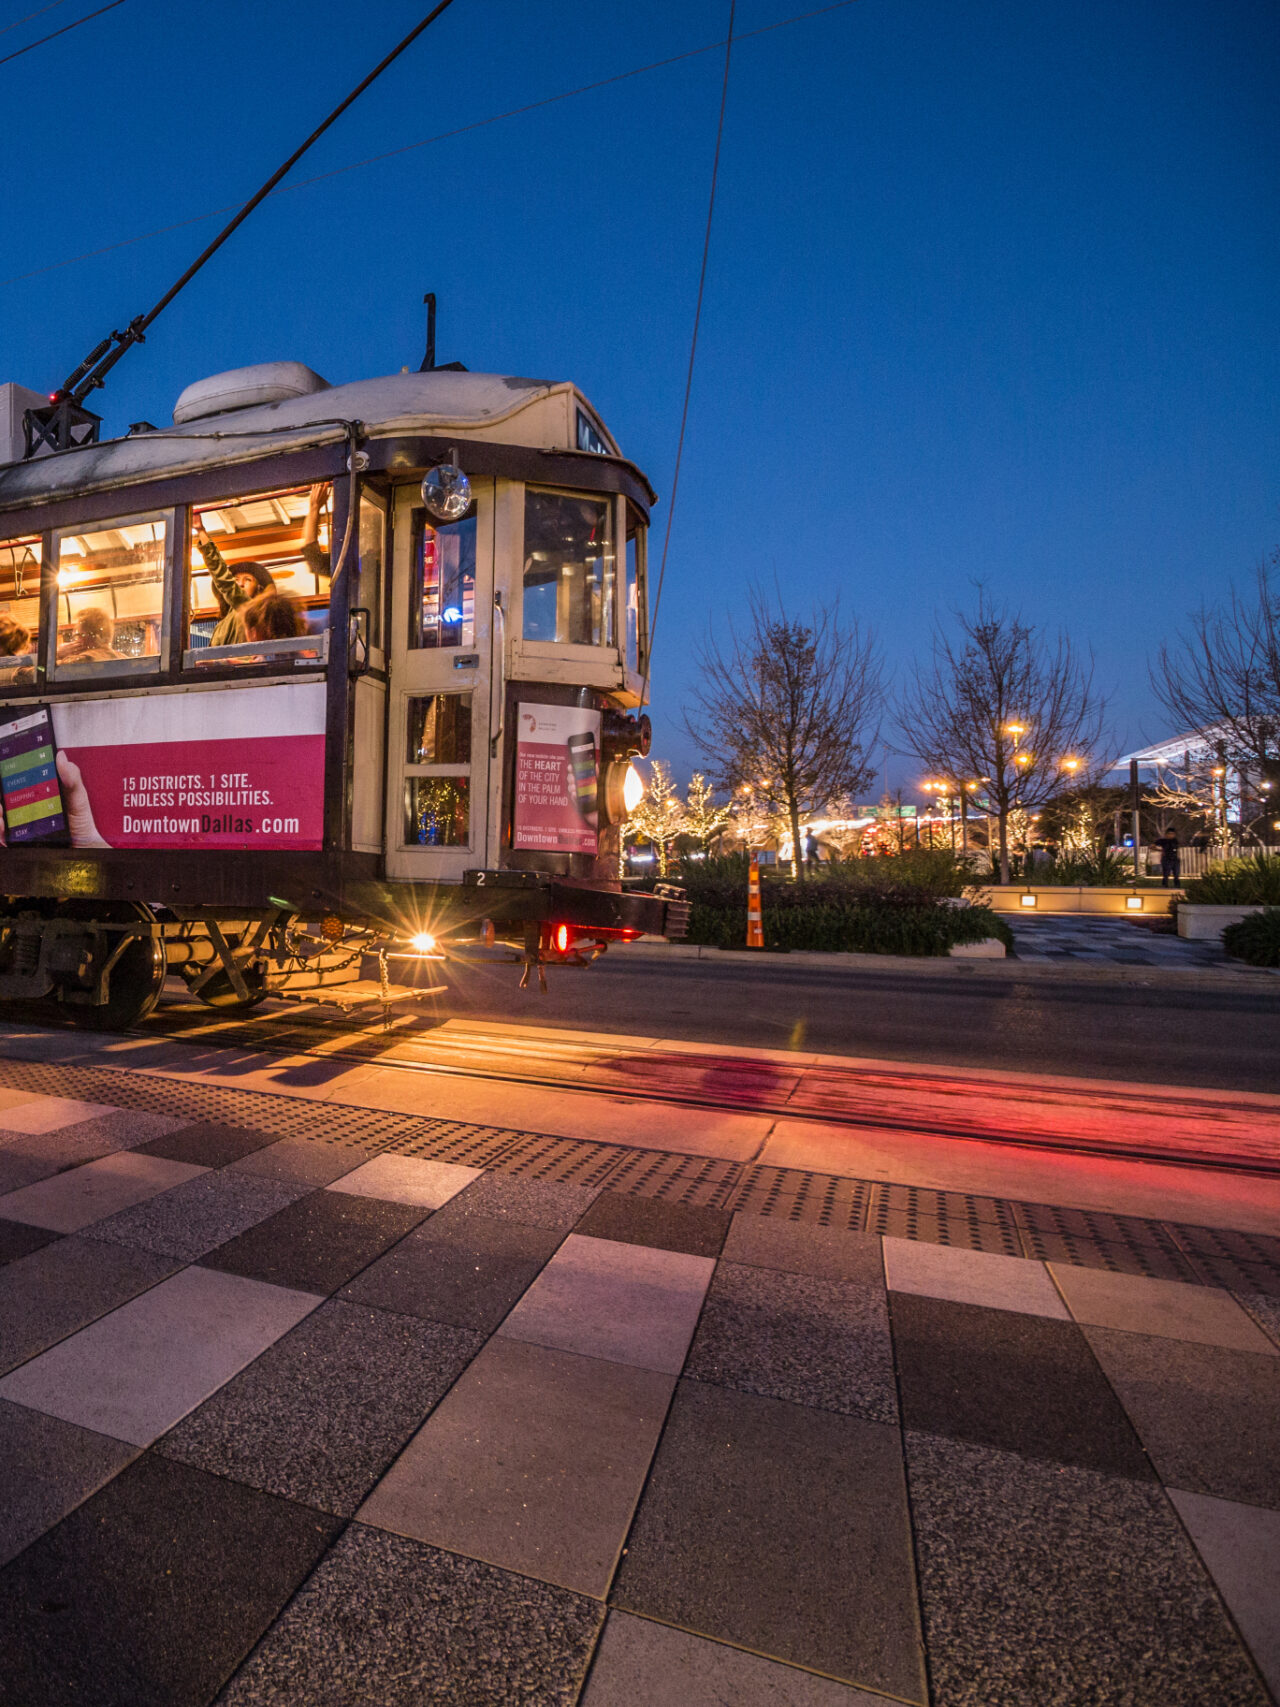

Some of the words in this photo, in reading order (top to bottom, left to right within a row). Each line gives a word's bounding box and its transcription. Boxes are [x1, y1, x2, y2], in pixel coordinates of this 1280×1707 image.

[519, 759, 533, 769] THE
[534, 761, 562, 771] HEART
[122, 777, 136, 791] 15
[139, 774, 205, 790] DISTRICTS.
[209, 775, 216, 788] 1
[220, 773, 253, 788] SITE.
[518, 771, 529, 780] OF
[530, 771, 543, 782] THE
[543, 772, 561, 782] CITY
[518, 782, 526, 791] IN
[527, 783, 541, 792] THE
[542, 784, 561, 794] PALM
[123, 792, 175, 807] ENDLESS
[178, 790, 274, 807] POSSIBILITIES.
[518, 794, 528, 803] OF
[529, 794, 548, 805] YOUR
[549, 796, 568, 806] HAND
[122, 814, 300, 833] DowntownDallas.com
[476, 871, 486, 887] 2
